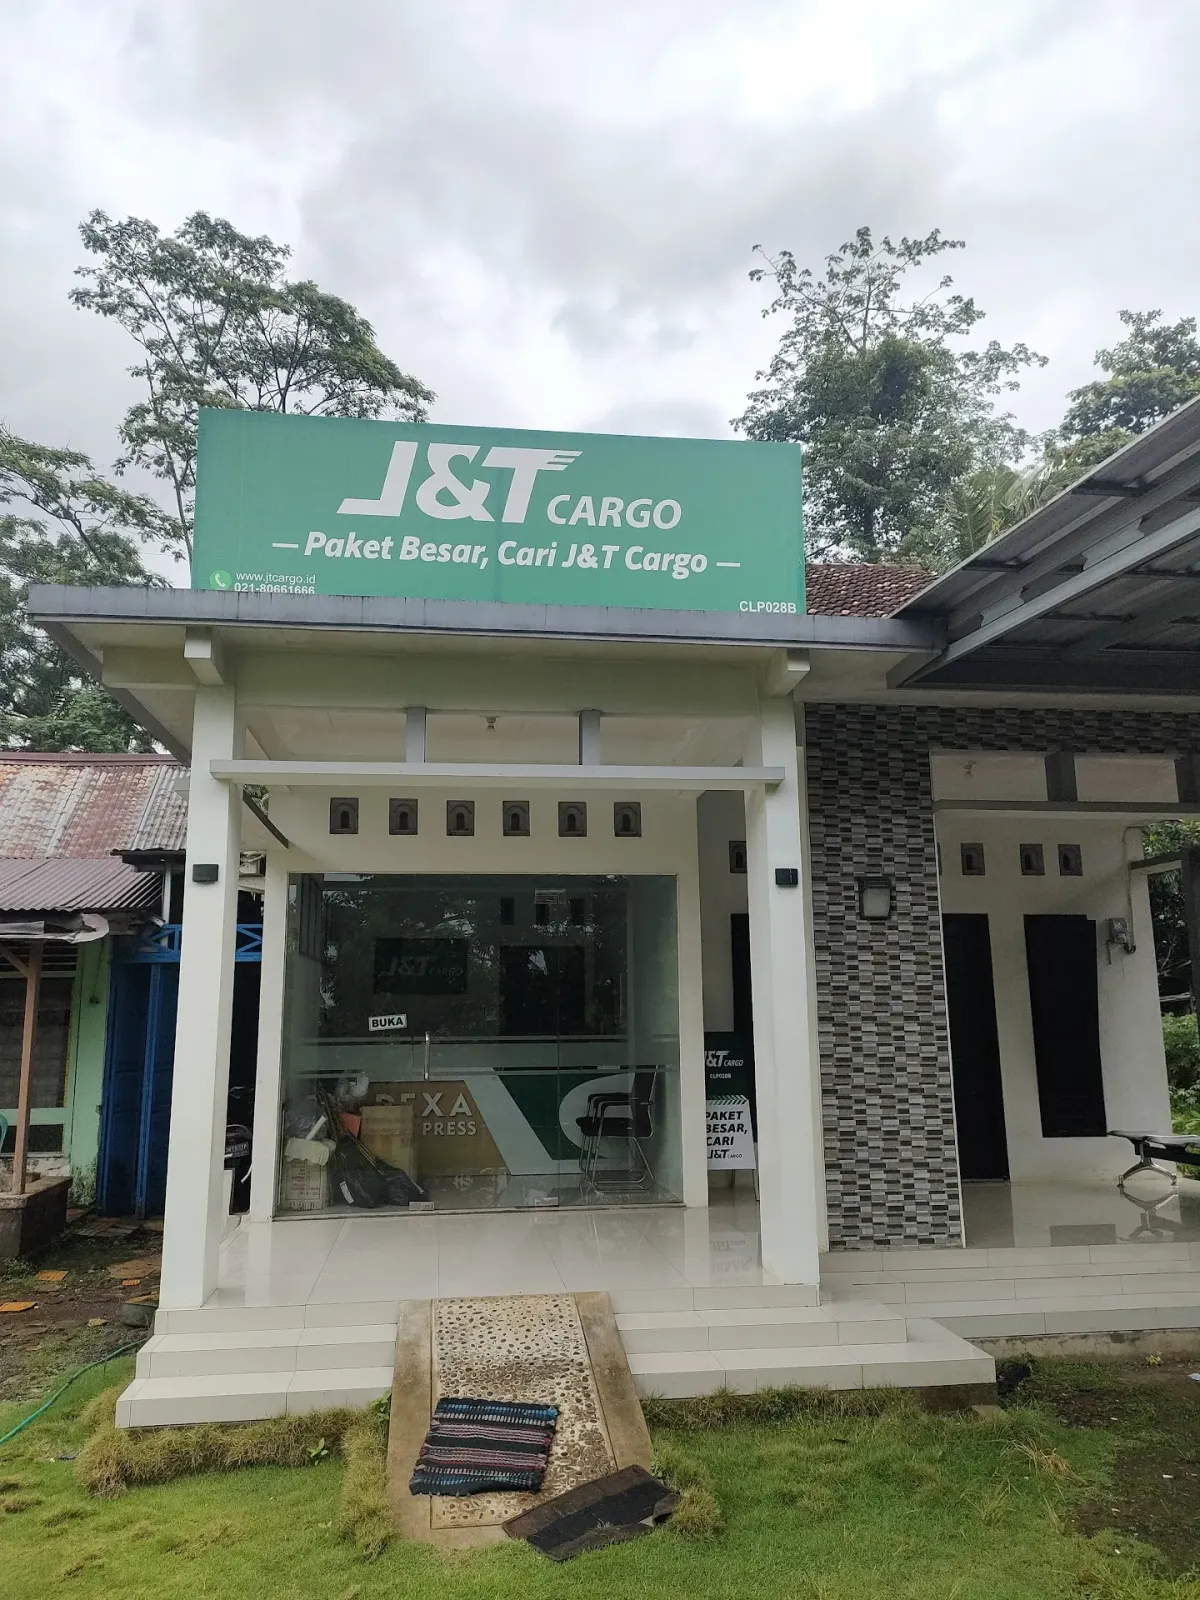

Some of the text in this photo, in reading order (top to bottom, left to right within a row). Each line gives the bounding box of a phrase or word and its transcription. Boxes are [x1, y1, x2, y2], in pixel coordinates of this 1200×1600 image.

[336, 440, 682, 530] J&T CARGO
[304, 531, 708, 580] Paket Besar, Cari J&T Cargo
[235, 571, 316, 586] www.jtcargo.id
[234, 582, 315, 595] 021-80661666
[739, 600, 797, 614] CLP028B
[372, 1017, 404, 1028] BUKA
[723, 1059, 744, 1067] CARGO
[422, 1121, 478, 1136] PRESS
[706, 1136, 734, 1147] CARI
